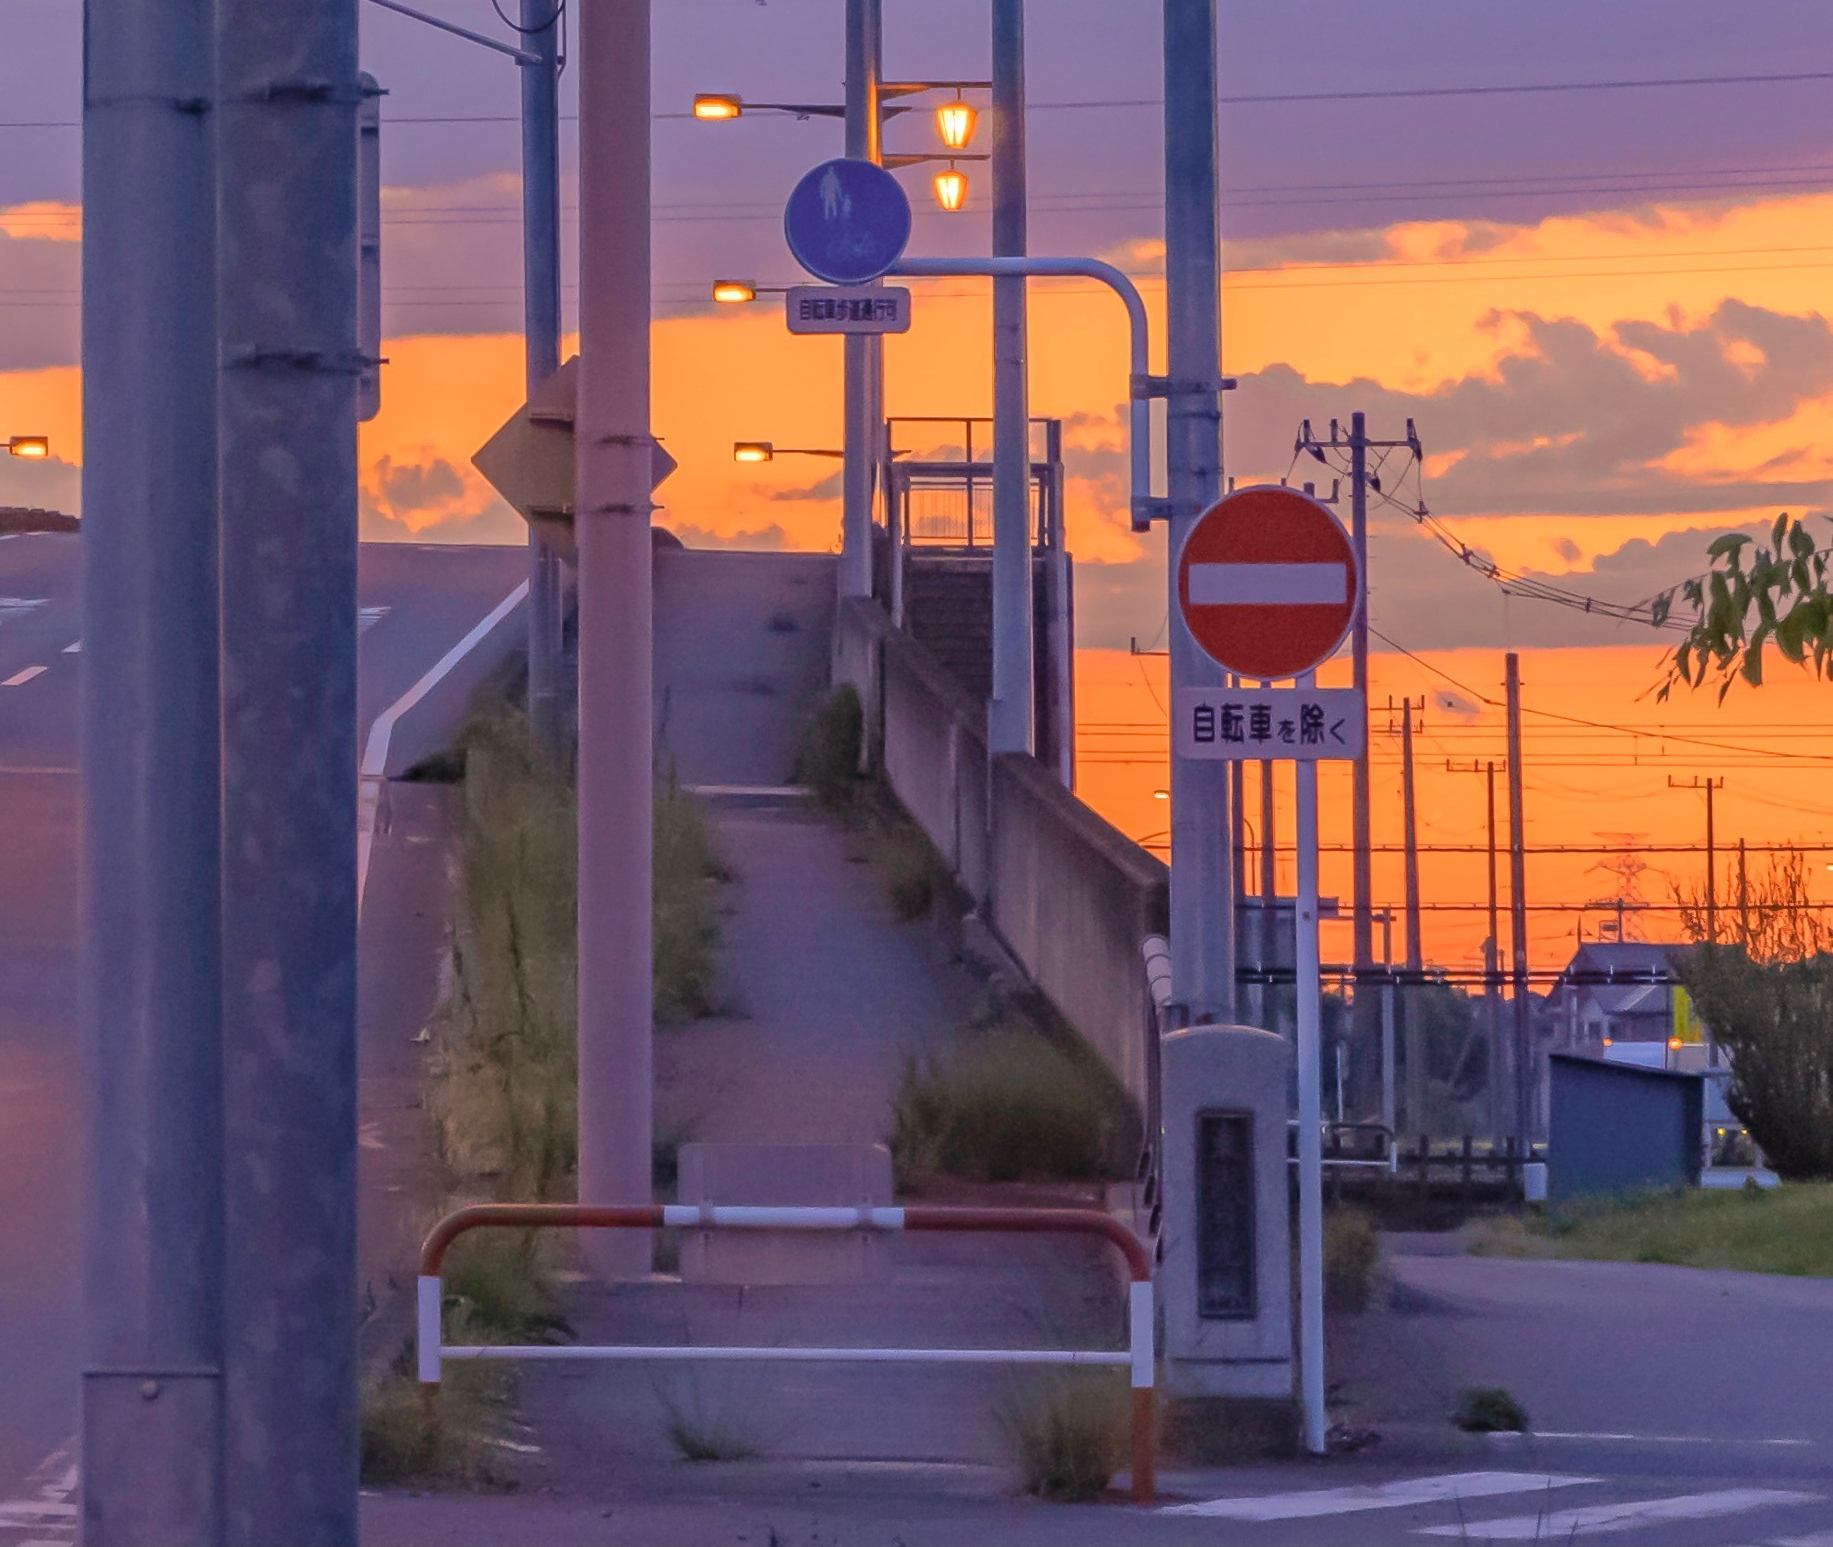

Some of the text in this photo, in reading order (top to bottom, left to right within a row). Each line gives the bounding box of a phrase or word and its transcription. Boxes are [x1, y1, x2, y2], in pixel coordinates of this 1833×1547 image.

[1193, 702, 1346, 744] 自転車を除く
